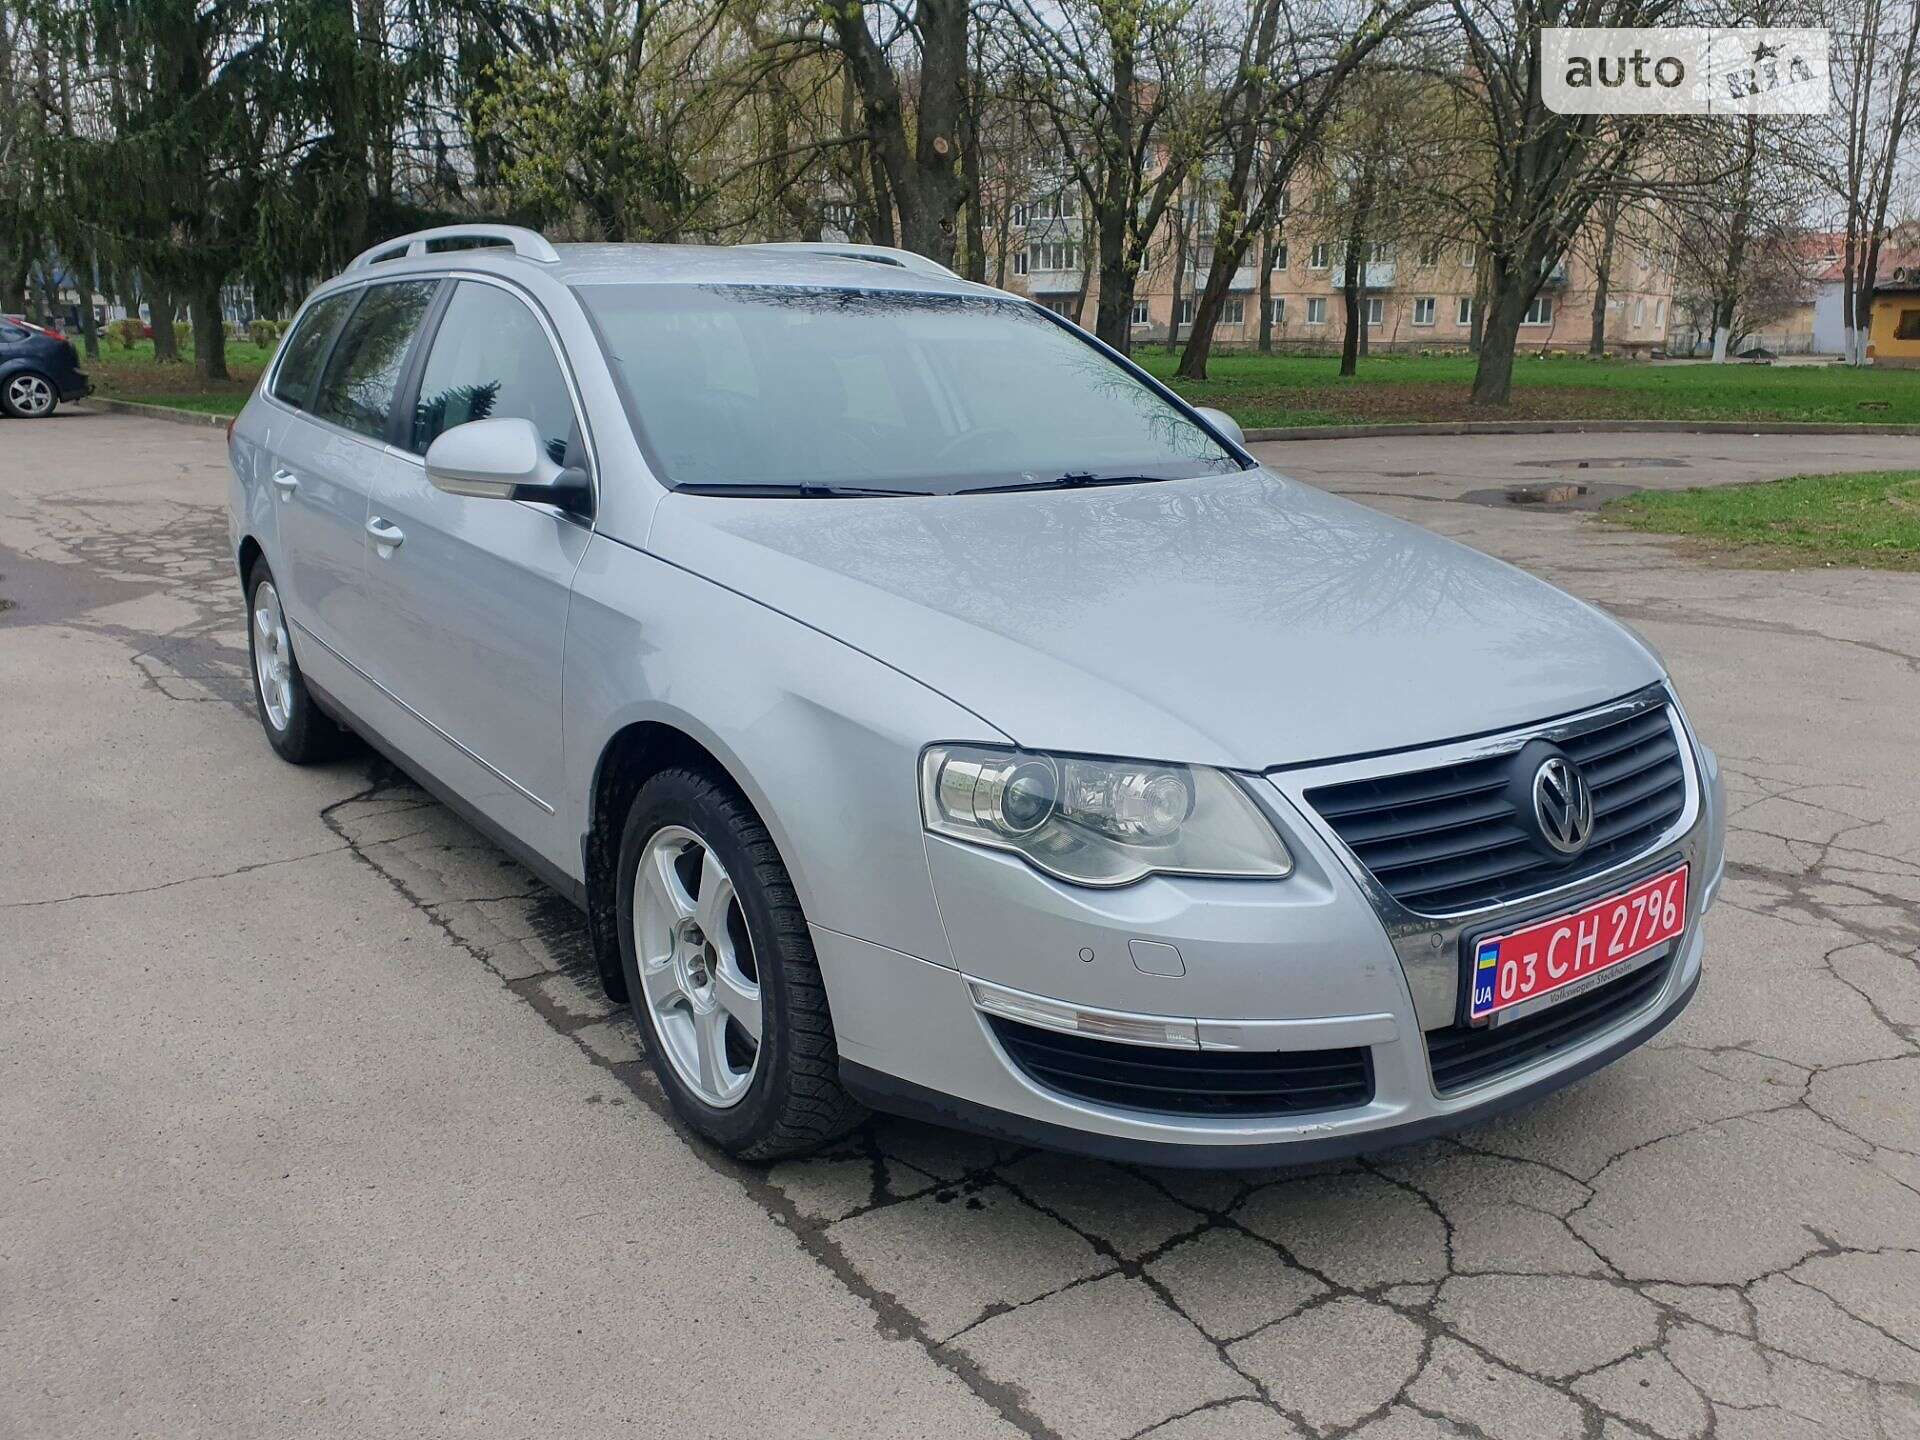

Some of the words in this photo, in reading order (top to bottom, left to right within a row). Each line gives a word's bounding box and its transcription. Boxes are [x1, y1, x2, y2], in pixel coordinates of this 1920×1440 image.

[1501, 953, 1538, 1000] 03
[1547, 915, 1599, 979] CH
[1608, 880, 1678, 957] 2796
[1474, 988, 1492, 1005] UA
